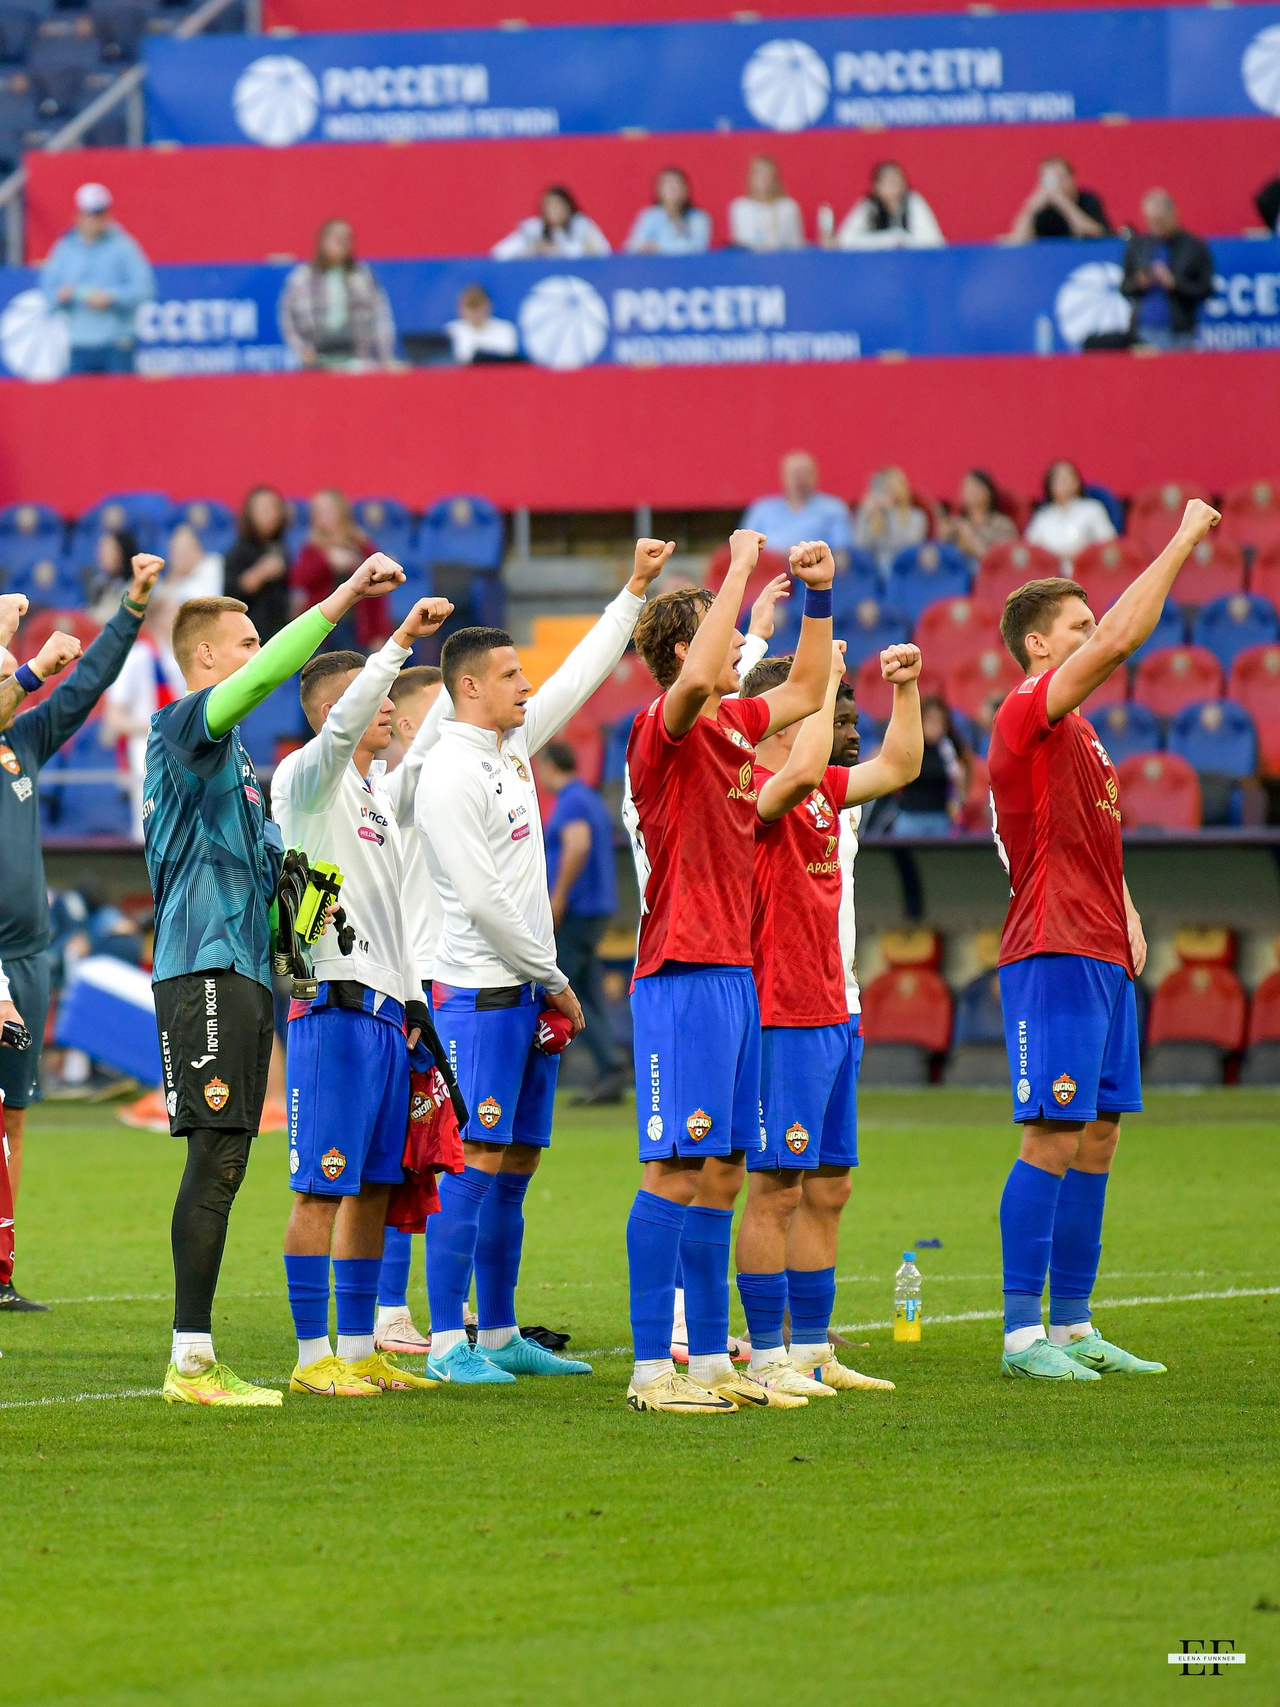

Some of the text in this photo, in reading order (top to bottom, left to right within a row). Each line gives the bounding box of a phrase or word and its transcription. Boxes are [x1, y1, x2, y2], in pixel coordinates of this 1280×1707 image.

[322, 64, 488, 107] РОССЕТИ
[833, 47, 1003, 91] РОССЕТИ
[134, 298, 258, 342] ССЕТИ
[613, 285, 787, 333] РОССЕТИ
[204, 978, 219, 1052] ПОЧТА РОССИИ
[161, 1030, 175, 1089] РОССЕТИ
[448, 1040, 458, 1079] ССЕТИ
[1018, 1020, 1028, 1076] РОССЕТИ
[207, 1086, 227, 1097] ЦСКА
[650, 1053, 660, 1112] РОССЕТИ
[1054, 1082, 1075, 1092] ЦСКА
[290, 1088, 300, 1146] РОССЕТИ
[478, 1105, 501, 1115] ЦСКА
[688, 1117, 711, 1128] ЦСКА
[787, 1130, 808, 1141] ЦСКА
[322, 1156, 344, 1167] ЦСКА
